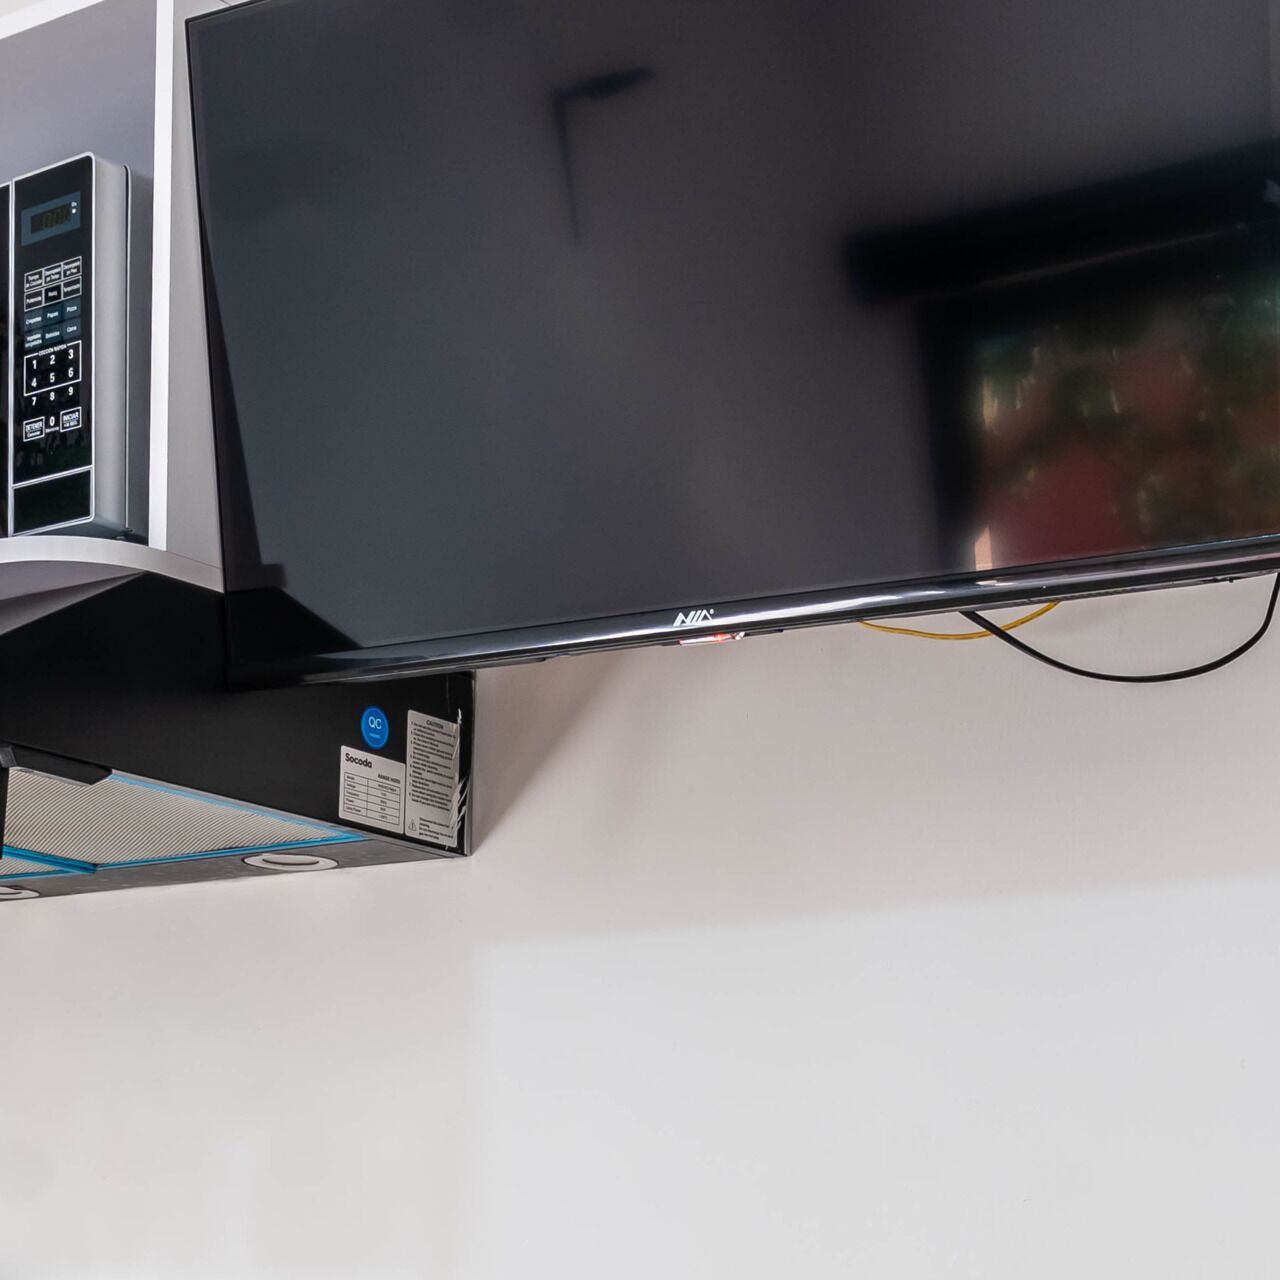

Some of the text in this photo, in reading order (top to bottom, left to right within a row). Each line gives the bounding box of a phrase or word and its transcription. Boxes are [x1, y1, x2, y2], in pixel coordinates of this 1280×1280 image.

[32, 349, 73, 369] 1 2 3
[31, 367, 73, 387] 4 5 6
[32, 386, 73, 405] 7 8 9
[50, 416, 55, 426] 0
[368, 716, 381, 730] QC
[345, 752, 372, 768] Socoda
